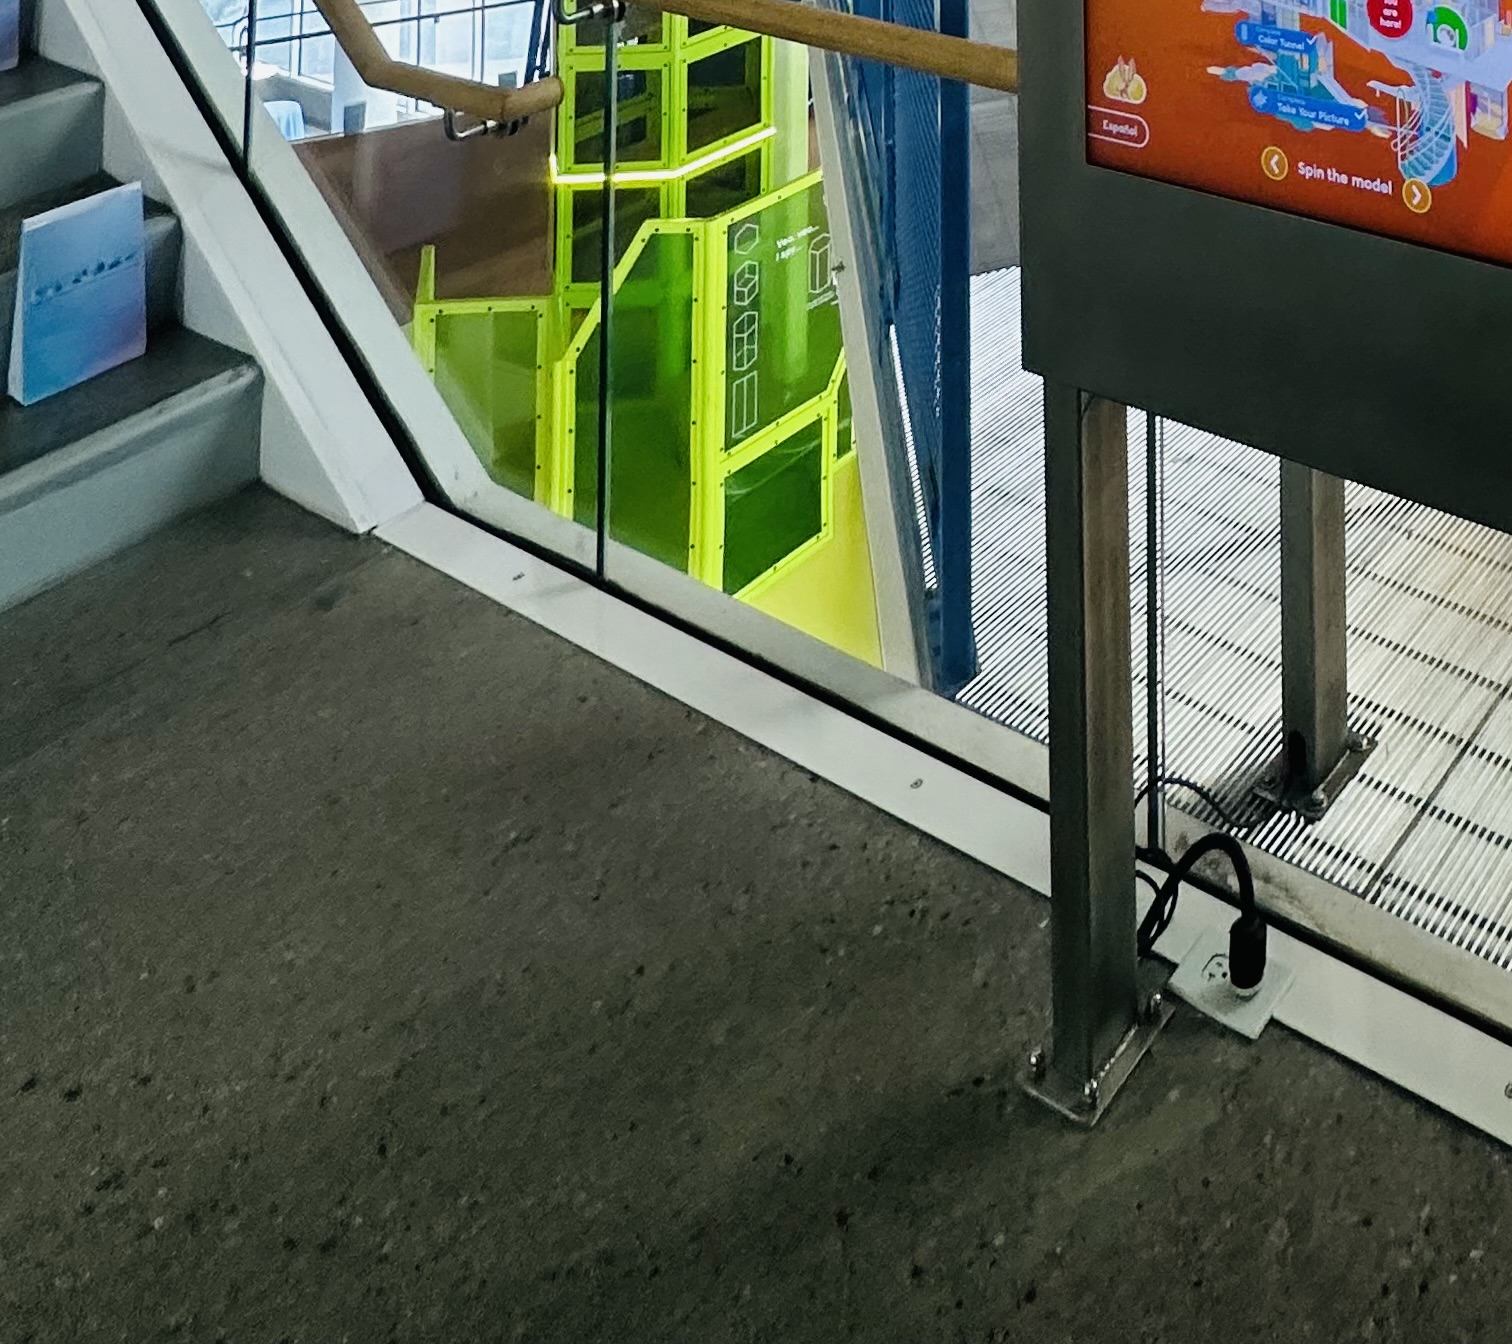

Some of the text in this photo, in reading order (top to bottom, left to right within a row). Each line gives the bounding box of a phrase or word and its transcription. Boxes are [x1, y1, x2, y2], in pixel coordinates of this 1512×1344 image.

[1382, 8, 1398, 17] are
[1258, 35, 1305, 50] Color Tunnel
[1277, 102, 1350, 127] Take Your Picture
[1298, 162, 1393, 195] Spin the model
